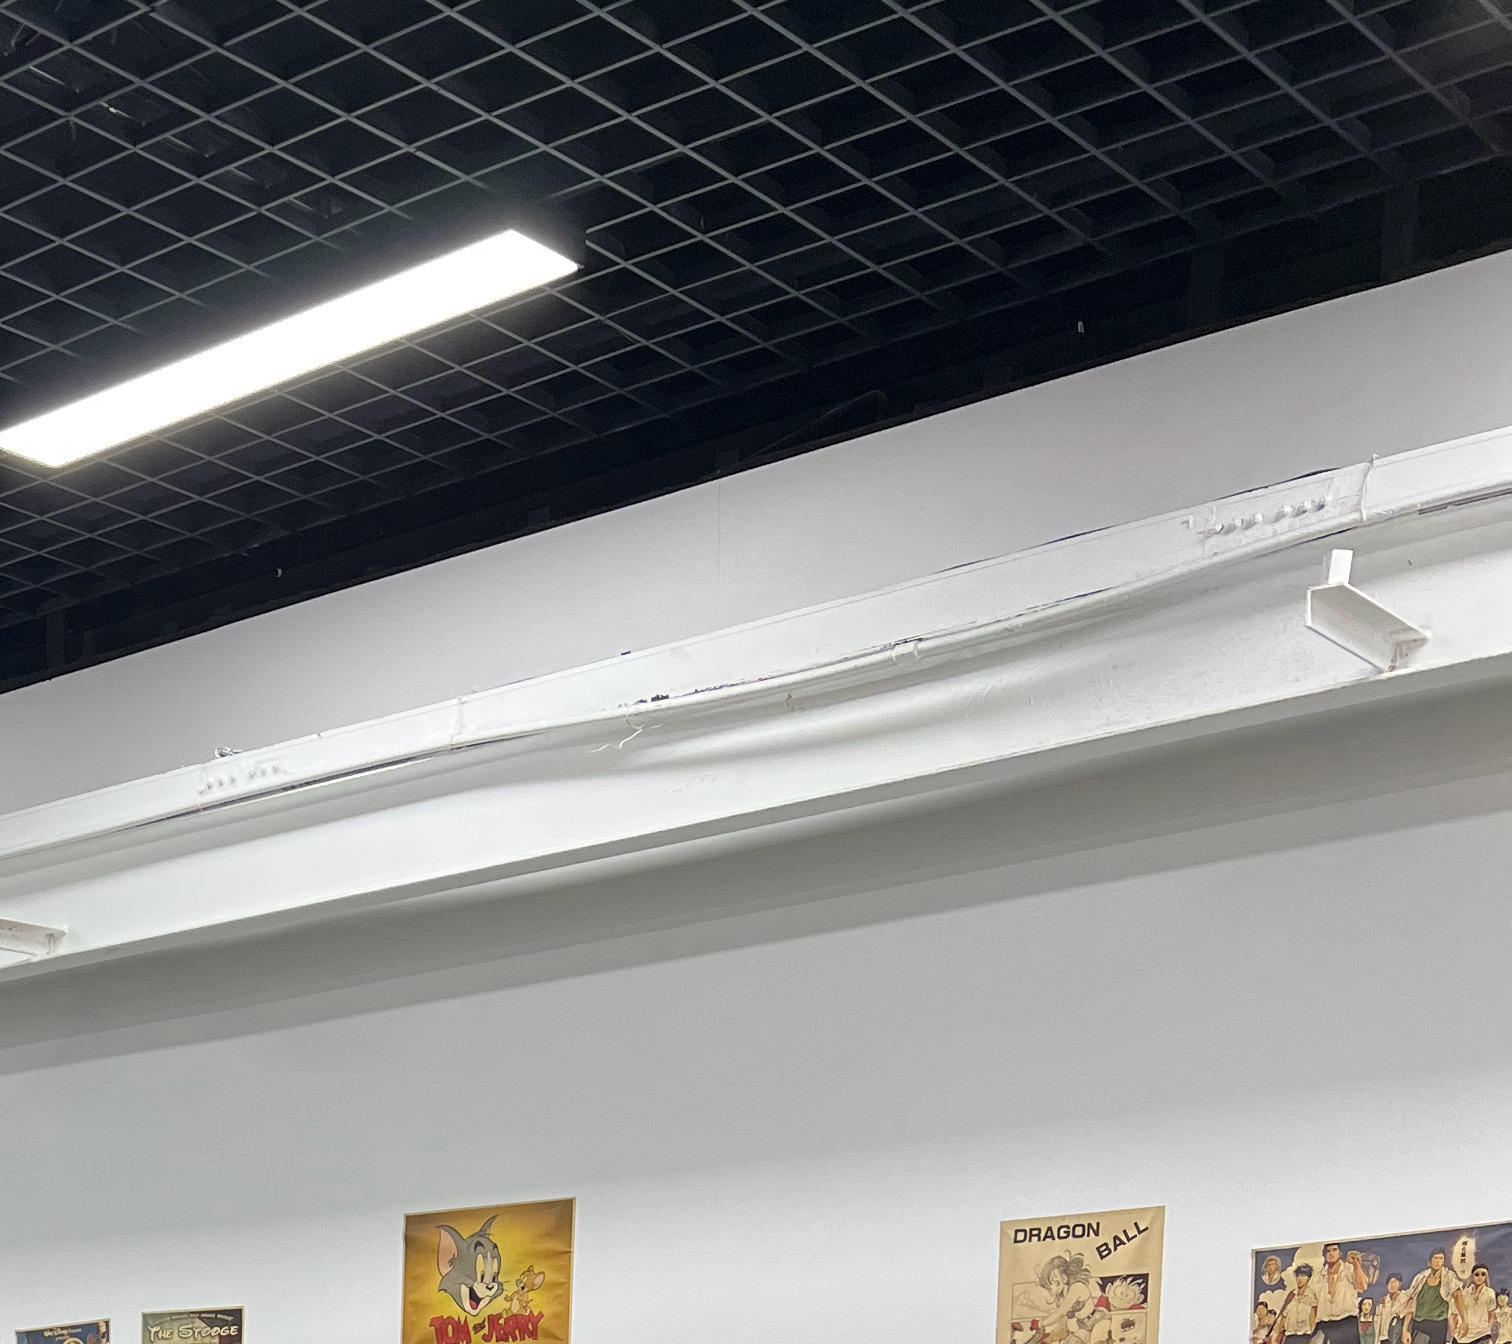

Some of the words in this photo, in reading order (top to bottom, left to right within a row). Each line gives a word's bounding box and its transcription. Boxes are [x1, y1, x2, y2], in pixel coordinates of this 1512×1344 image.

[1013, 1221, 1101, 1244] DRAGON
[1095, 1221, 1150, 1260] BALL
[148, 1325, 174, 1342] THE
[178, 1323, 239, 1340] STOOGE
[482, 1310, 544, 1343] JERRY
